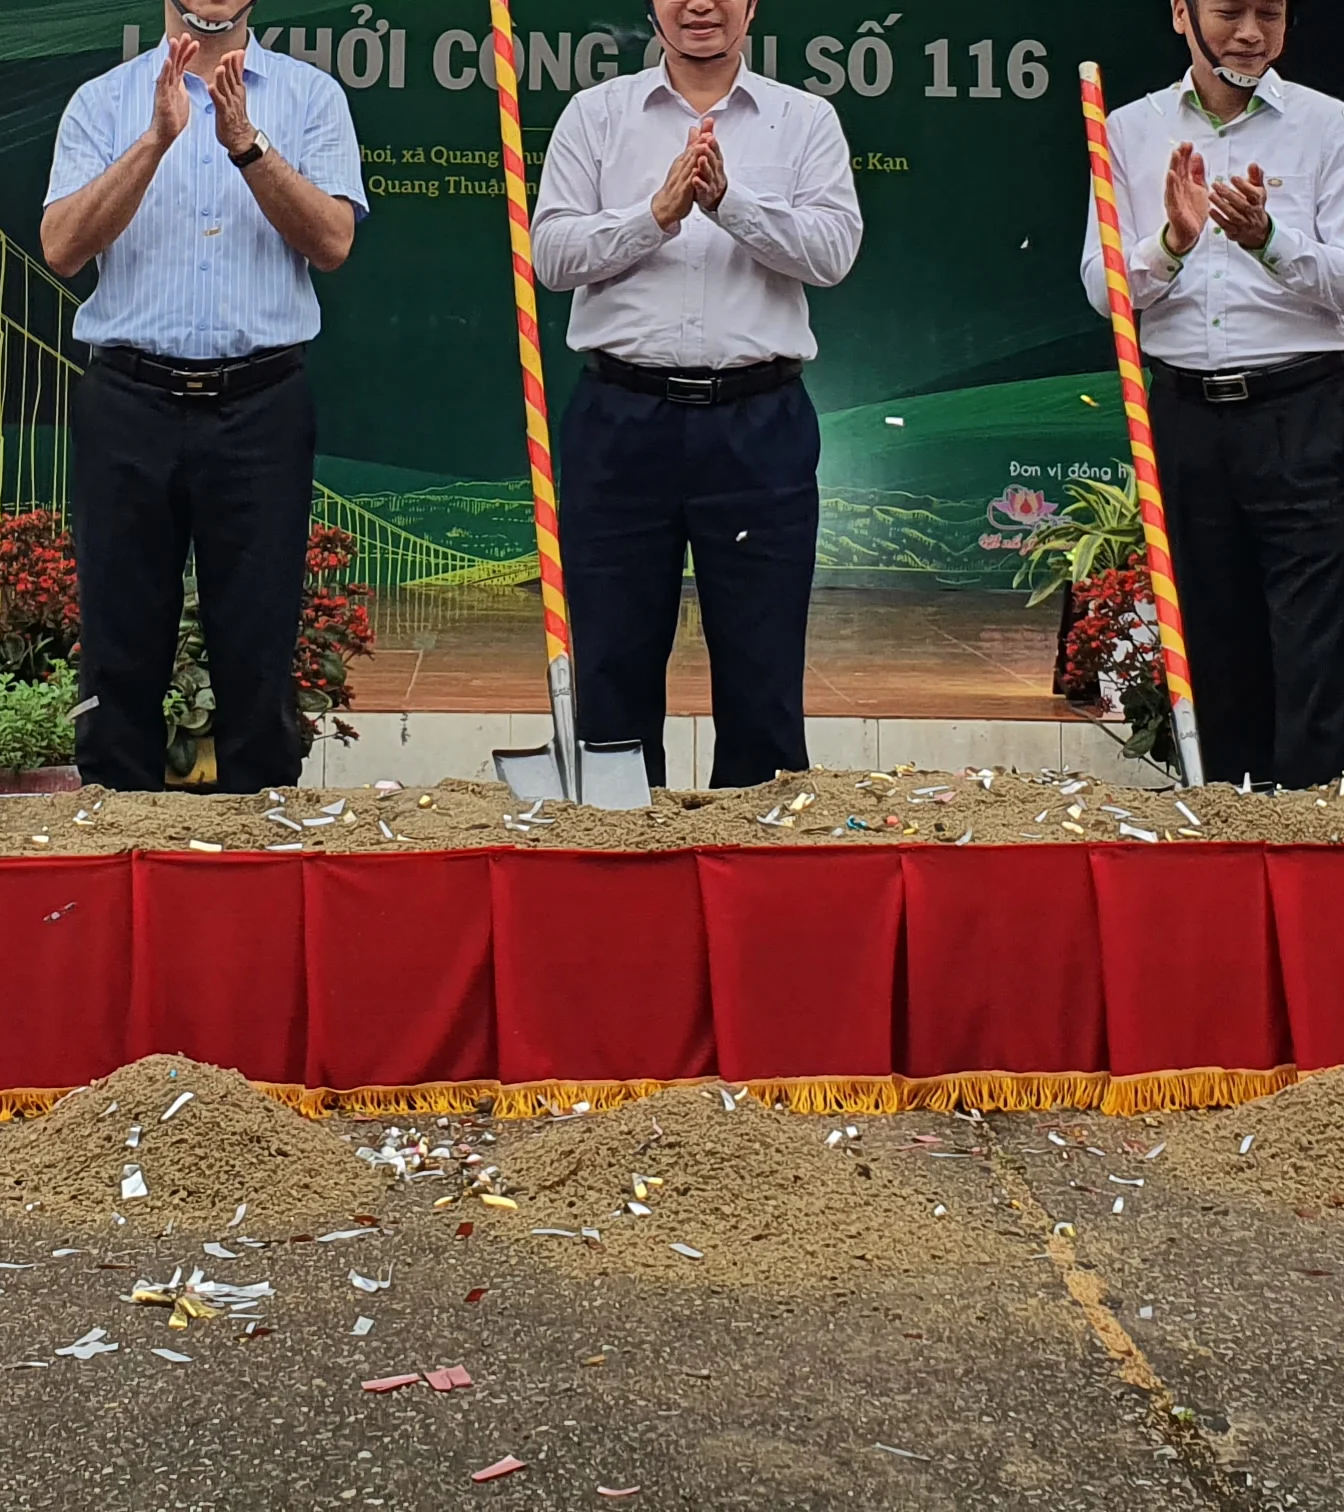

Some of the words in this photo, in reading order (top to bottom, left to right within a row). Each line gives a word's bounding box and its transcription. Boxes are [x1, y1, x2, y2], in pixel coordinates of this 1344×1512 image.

[803, 13, 904, 98] SỐ
[924, 38, 1050, 100] 116
[401, 147, 425, 163] xã
[430, 146, 500, 168] Quang
[867, 152, 909, 173] Kạn
[368, 175, 440, 197] Quang
[1009, 461, 1041, 477] Đơn
[1047, 462, 1062, 480] vị
